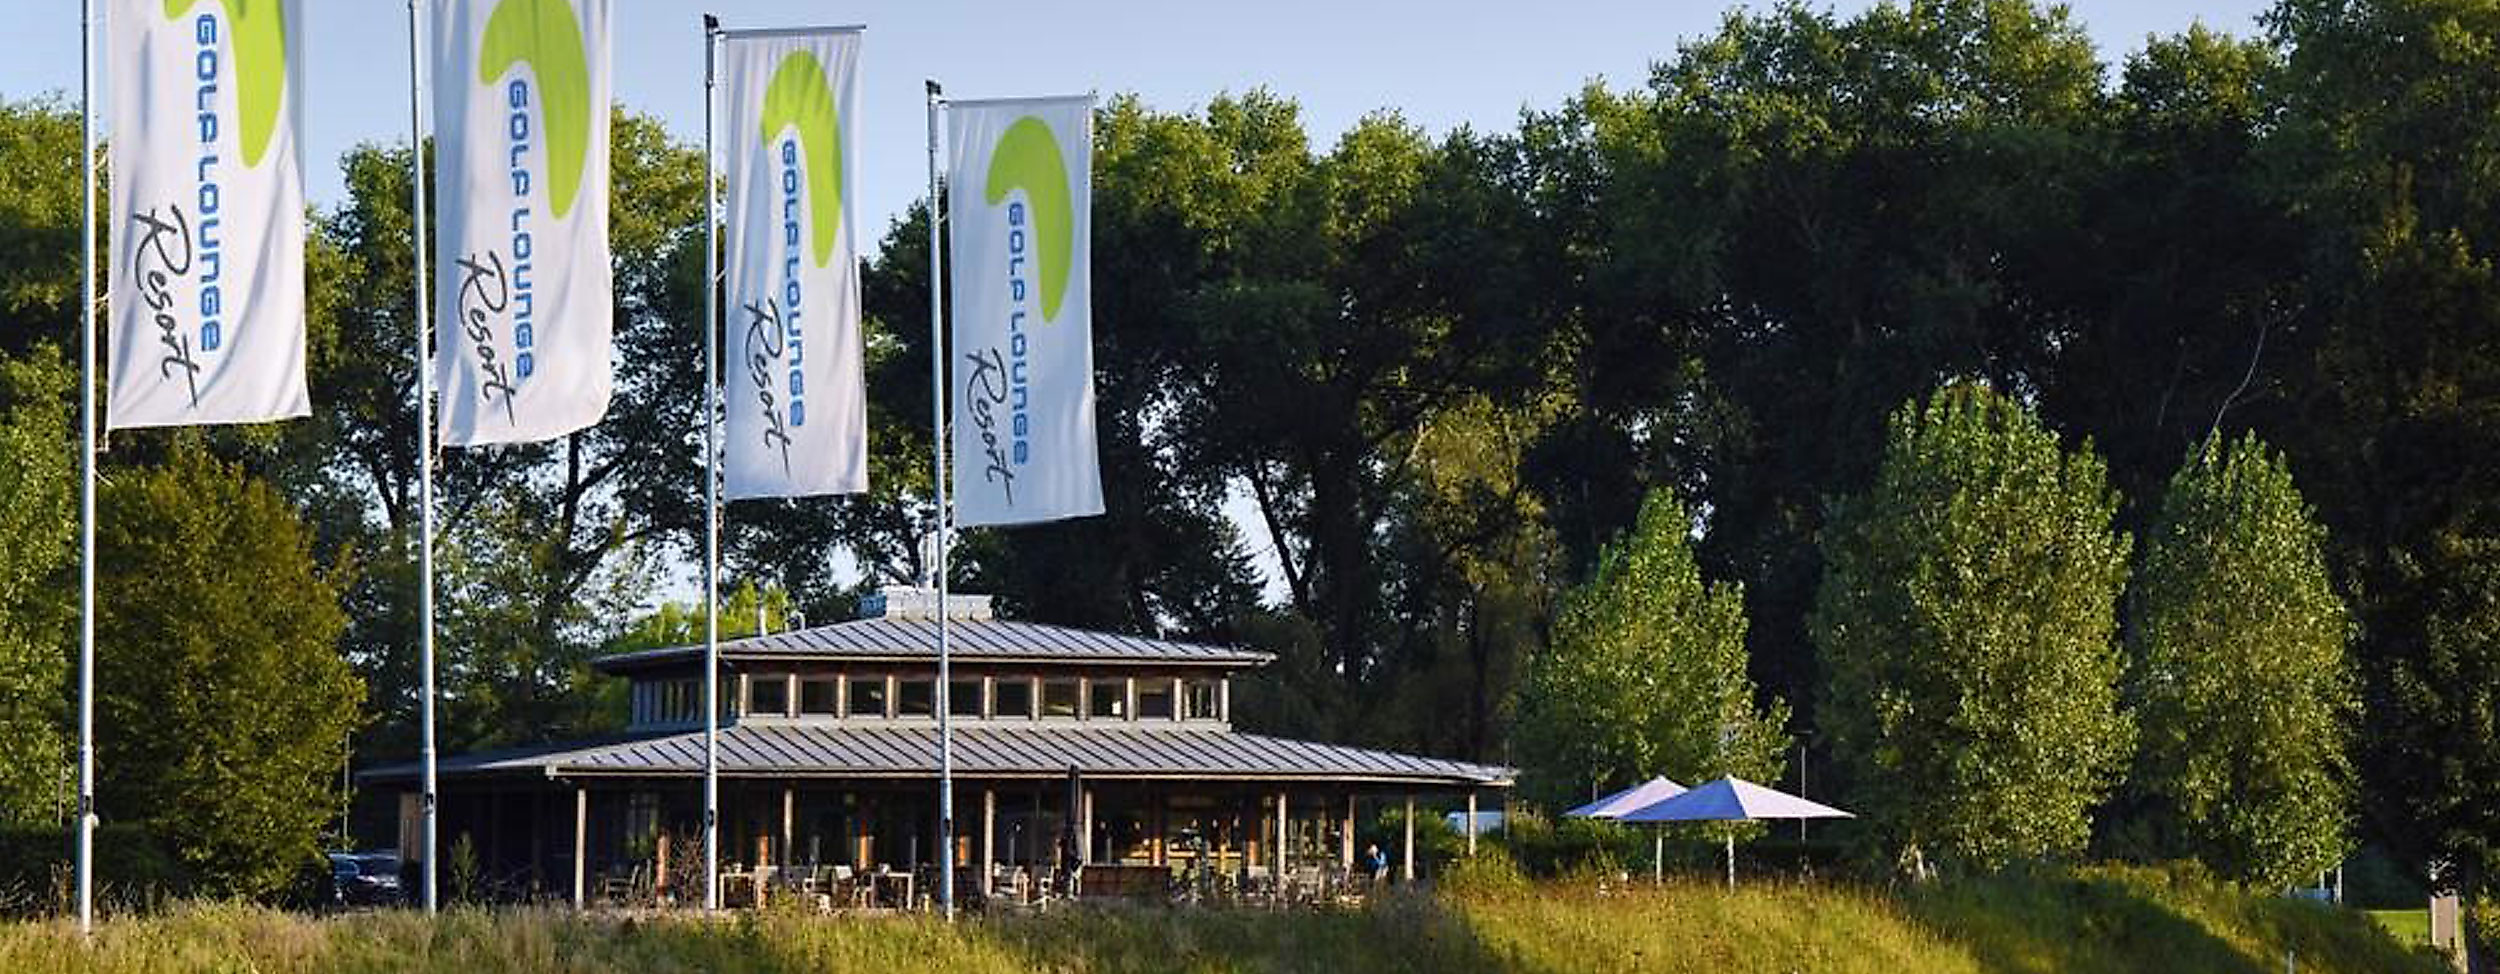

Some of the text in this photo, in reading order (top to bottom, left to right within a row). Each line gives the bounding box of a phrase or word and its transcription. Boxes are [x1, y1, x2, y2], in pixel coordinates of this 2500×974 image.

[196, 14, 223, 352] GOLF LOUNGE
[508, 79, 535, 379] GOLF LOUNGE
[781, 139, 805, 427] GOLF LOUNGE
[133, 203, 200, 408] Resort
[456, 250, 517, 426] Resort
[743, 297, 791, 478] Resort
[1008, 202, 1029, 465] GOLF LOUNGE
[965, 347, 1015, 506] Resort
